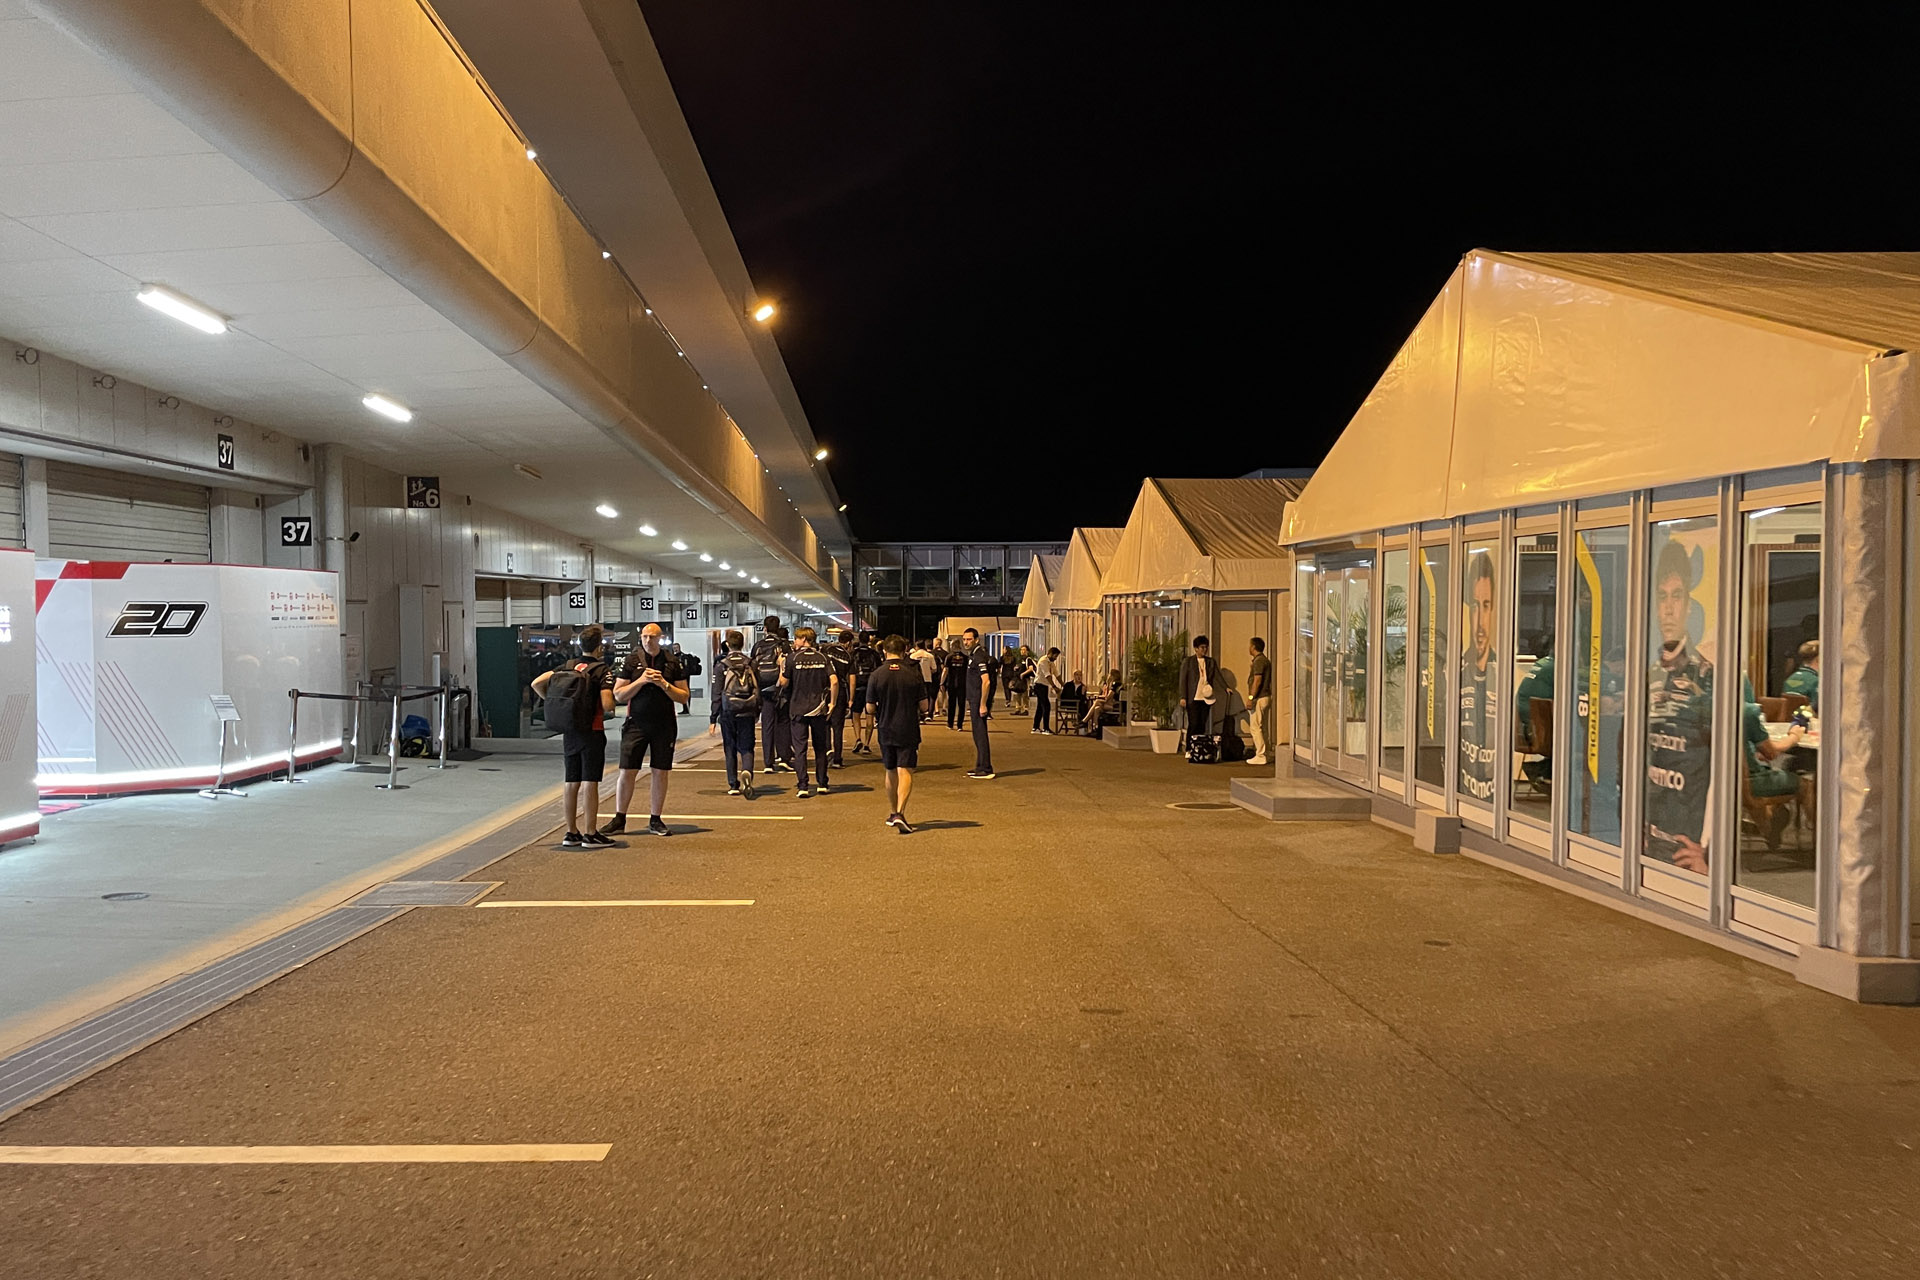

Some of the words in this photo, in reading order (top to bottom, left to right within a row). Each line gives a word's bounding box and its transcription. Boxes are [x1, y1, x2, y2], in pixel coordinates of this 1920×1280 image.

[220, 440, 233, 465] 37
[283, 521, 310, 542] 37
[570, 594, 585, 607] 35
[641, 599, 653, 609] 33
[106, 601, 209, 638] 20
[687, 610, 696, 619] 31
[1578, 693, 1589, 717] 18
[1589, 696, 1599, 760] STROLL
